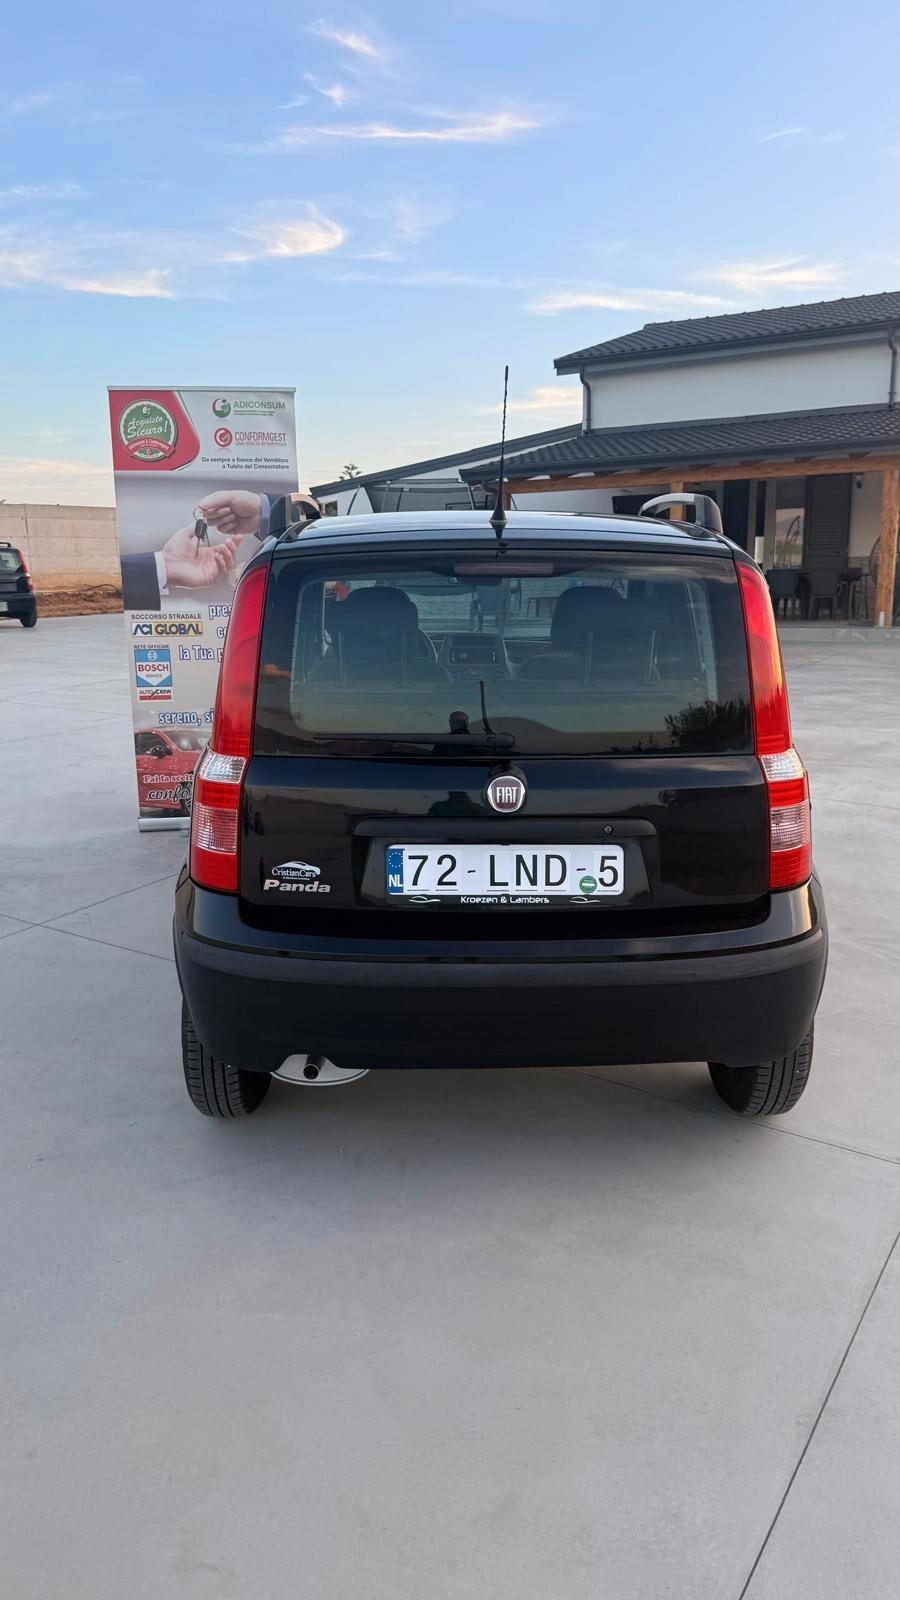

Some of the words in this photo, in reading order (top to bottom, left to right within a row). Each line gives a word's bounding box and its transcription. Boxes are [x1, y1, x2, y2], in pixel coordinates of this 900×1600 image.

[234, 401, 286, 409] ADICONSUM
[128, 416, 163, 428] Acquisto
[127, 420, 168, 438] Sicuro!
[235, 432, 286, 441] CONFORMGEST
[133, 624, 152, 635] ACI
[155, 624, 203, 635] GLOBAL
[179, 645, 191, 660] la
[192, 645, 214, 660] Tua
[159, 712, 201, 726] sereno,
[143, 775, 160, 783] Fai
[496, 786, 518, 803] FIAT
[271, 868, 316, 877] CristianCars
[263, 879, 331, 893] Panda
[388, 874, 404, 887] NL
[509, 896, 549, 904] Lambers
